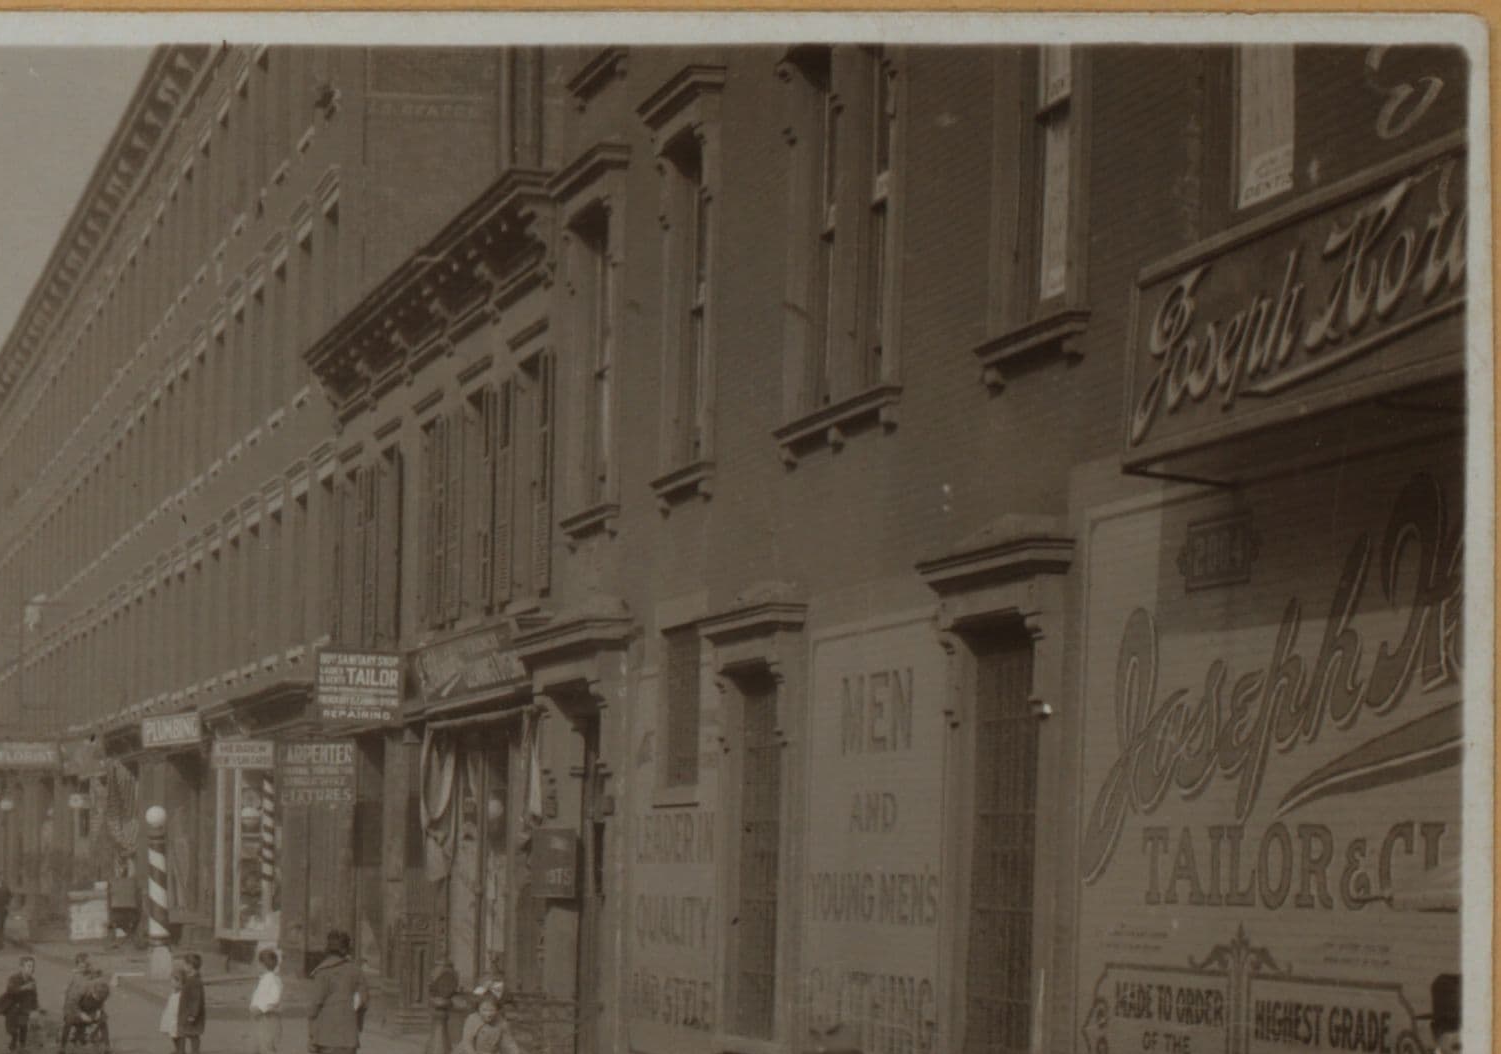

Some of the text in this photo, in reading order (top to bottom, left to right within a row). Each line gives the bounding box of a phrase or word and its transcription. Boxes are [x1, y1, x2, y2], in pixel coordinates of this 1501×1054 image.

[1131, 247, 1306, 446] Joseph
[346, 667, 399, 688] TAILOR
[840, 667, 915, 757] MEN
[1084, 533, 1372, 884] Joseph
[636, 811, 715, 865] LEADER IN
[849, 791, 898, 834] AND
[1141, 821, 1334, 910] TAILOR
[636, 893, 712, 949] QUALITY
[811, 864, 939, 926] YOUNG MEN'S
[1115, 980, 1225, 1026] MADE TO ORDER
[1254, 999, 1325, 1048] HIGHEST
[1141, 1031, 1159, 1051] OF
